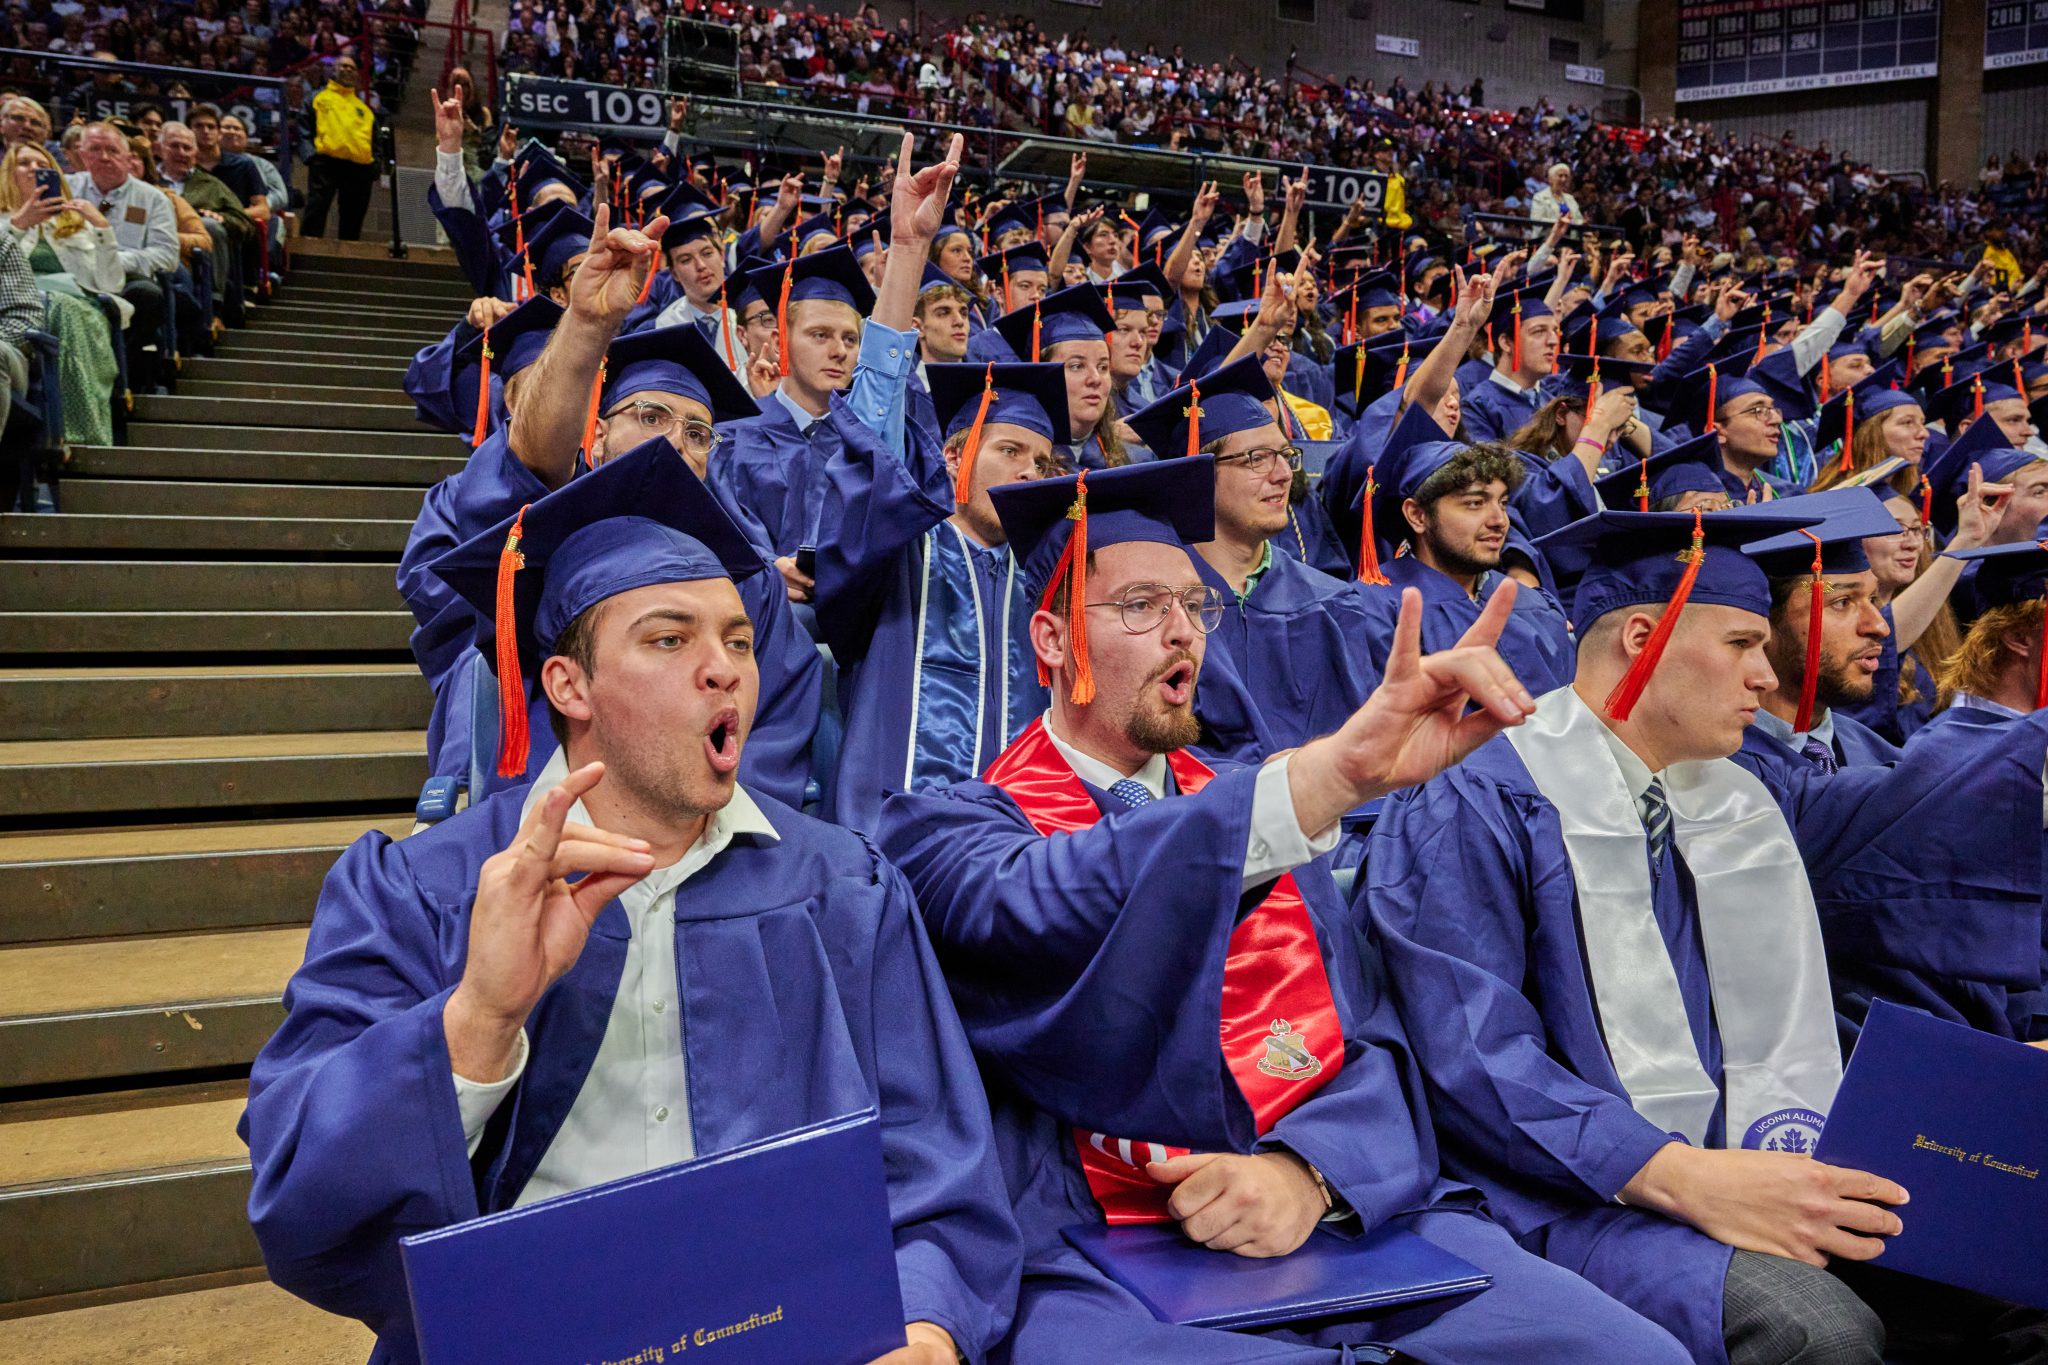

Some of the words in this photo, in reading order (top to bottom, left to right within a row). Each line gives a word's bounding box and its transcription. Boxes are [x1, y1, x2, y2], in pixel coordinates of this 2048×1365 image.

[1993, 52, 2048, 66] CONNE
[1682, 82, 1778, 99] CONNECTICUT
[1834, 66, 1928, 84] BASKETBALL
[96, 101, 130, 120] SE
[520, 93, 569, 114] SEC
[585, 90, 662, 125] 109
[1325, 175, 1382, 207] 109
[1755, 1112, 1791, 1134] UCONN
[1792, 1112, 1825, 1129] ALUMN
[1912, 1134, 1966, 1162] University
[1968, 1152, 1982, 1163] of
[1983, 1154, 2039, 1179] Connecticut
[671, 1335, 688, 1354] of
[693, 1305, 784, 1347] Connecticut
